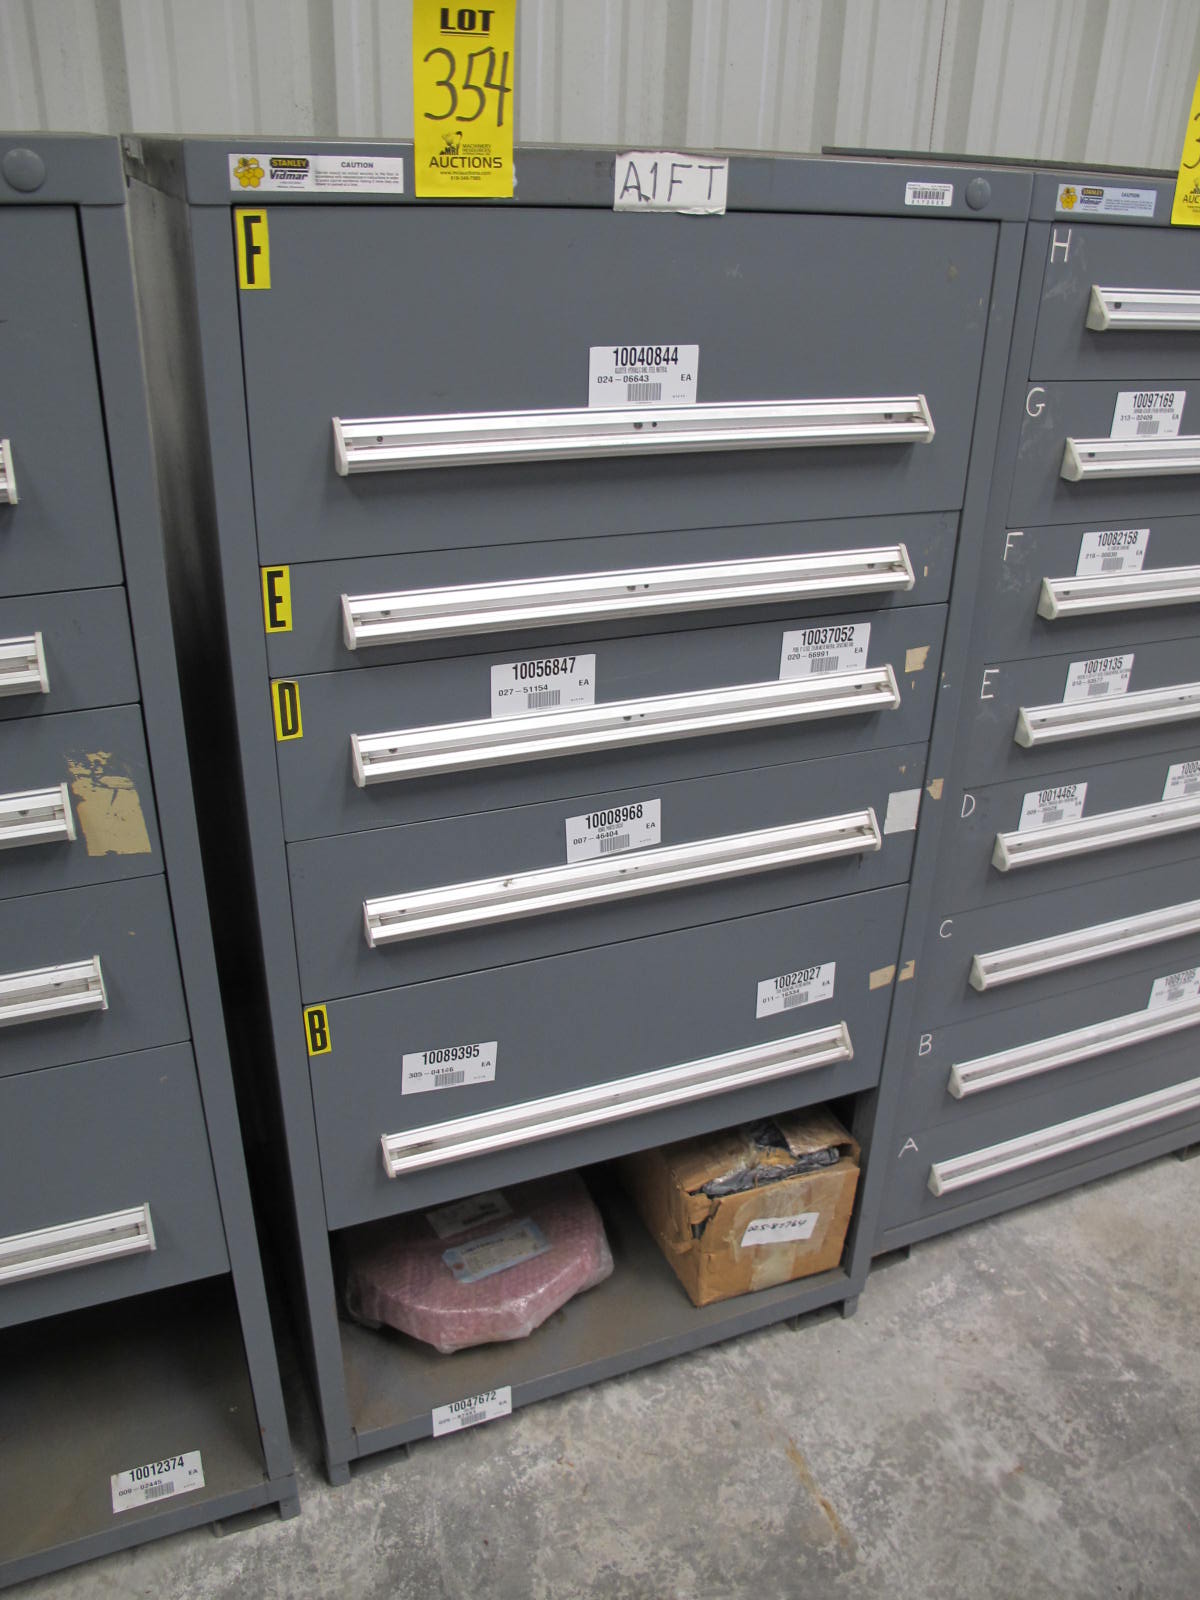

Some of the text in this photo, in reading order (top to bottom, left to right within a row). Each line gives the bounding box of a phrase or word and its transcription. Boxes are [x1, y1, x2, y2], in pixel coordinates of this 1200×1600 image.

[440, 8, 495, 33] LOT
[424, 47, 512, 127] 354
[271, 159, 307, 168] STANLEY
[340, 161, 374, 170] CAUTION
[429, 157, 503, 169] AUCTIONS
[270, 169, 309, 181] Vidmar
[243, 216, 262, 286] F
[1050, 228, 1072, 263] H
[612, 346, 679, 367] 10040844
[680, 373, 692, 382] EA
[1025, 387, 1046, 417] G
[1132, 393, 1175, 409] 10097169
[1003, 532, 1024, 561] F
[1098, 531, 1139, 547] 10082158
[267, 570, 288, 629] E
[802, 626, 855, 646] 10037052
[854, 646, 864, 654] EA
[512, 656, 577, 681] 10056847
[1083, 657, 1124, 675] 10019135
[579, 677, 591, 687] EA
[980, 669, 999, 699] E
[278, 682, 300, 738] D
[1037, 785, 1077, 804] 10014462
[585, 804, 644, 830] 10008968
[960, 794, 976, 818] D
[645, 821, 657, 830] EA
[939, 919, 953, 938] C
[773, 966, 821, 990] 10022027
[307, 1009, 329, 1053] B
[422, 1044, 480, 1065] 10089395
[918, 1033, 932, 1056] B
[897, 1137, 919, 1158] A
[447, 1390, 497, 1414] 10047672
[129, 1455, 185, 1482] 10012374
